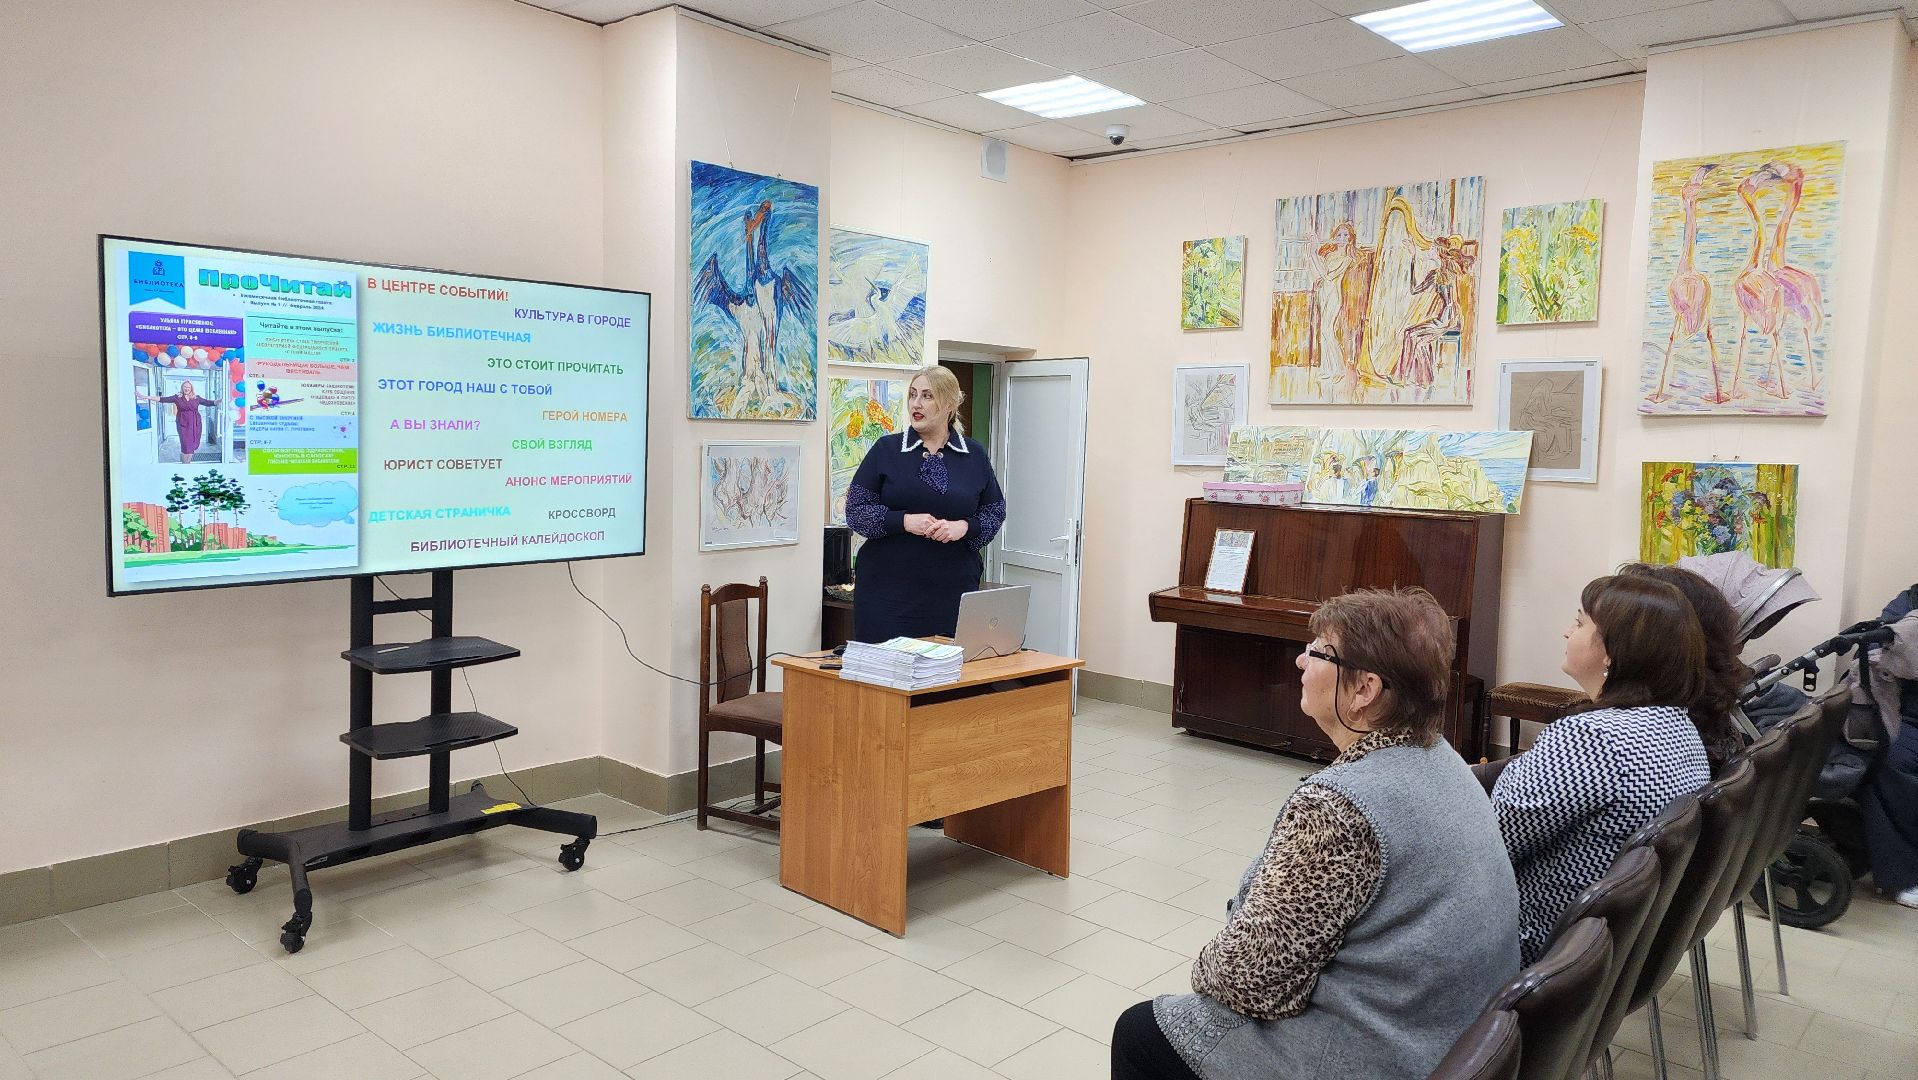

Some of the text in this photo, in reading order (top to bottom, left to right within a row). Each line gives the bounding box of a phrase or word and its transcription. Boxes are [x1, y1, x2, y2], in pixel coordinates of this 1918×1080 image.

[134, 279, 184, 288] БИБЛИОТЕКА
[199, 268, 352, 299] ПроЧитай
[368, 278, 509, 301] В ЦЕНТРЕ СОБЫТИЙ!
[260, 321, 288, 330] Читайте
[515, 308, 631, 328] КУЛЬТУРА В ГОРОДЕ
[373, 322, 531, 343] ЖИЗНЬ БИБЛИОТЕЧНАЯ
[488, 358, 624, 375] ЭТО СТОИТ ПРОЧИТАТЬ
[378, 379, 552, 395] ЭТОТ ГОРОД НАШ С ТОБОЙ
[543, 409, 627, 422] ГЕРОЙ НОМЕРА
[390, 419, 480, 430] А ВЫ ЗНАЛИ?
[512, 438, 593, 451] СВОЙ ВЗГЛЯД
[384, 458, 503, 470] ЮРИСТ СОВЕТУЕТ
[505, 472, 632, 487] АНОНС МЕРОПРИЯТИЙ
[368, 505, 511, 524] ДЕТСКАЯ СТРАНИЧКА
[549, 507, 616, 520] КРОССВОРД
[411, 530, 605, 552] БИБЛИОТЕЧНЫЙ КАЛЕЙДОСКОП
